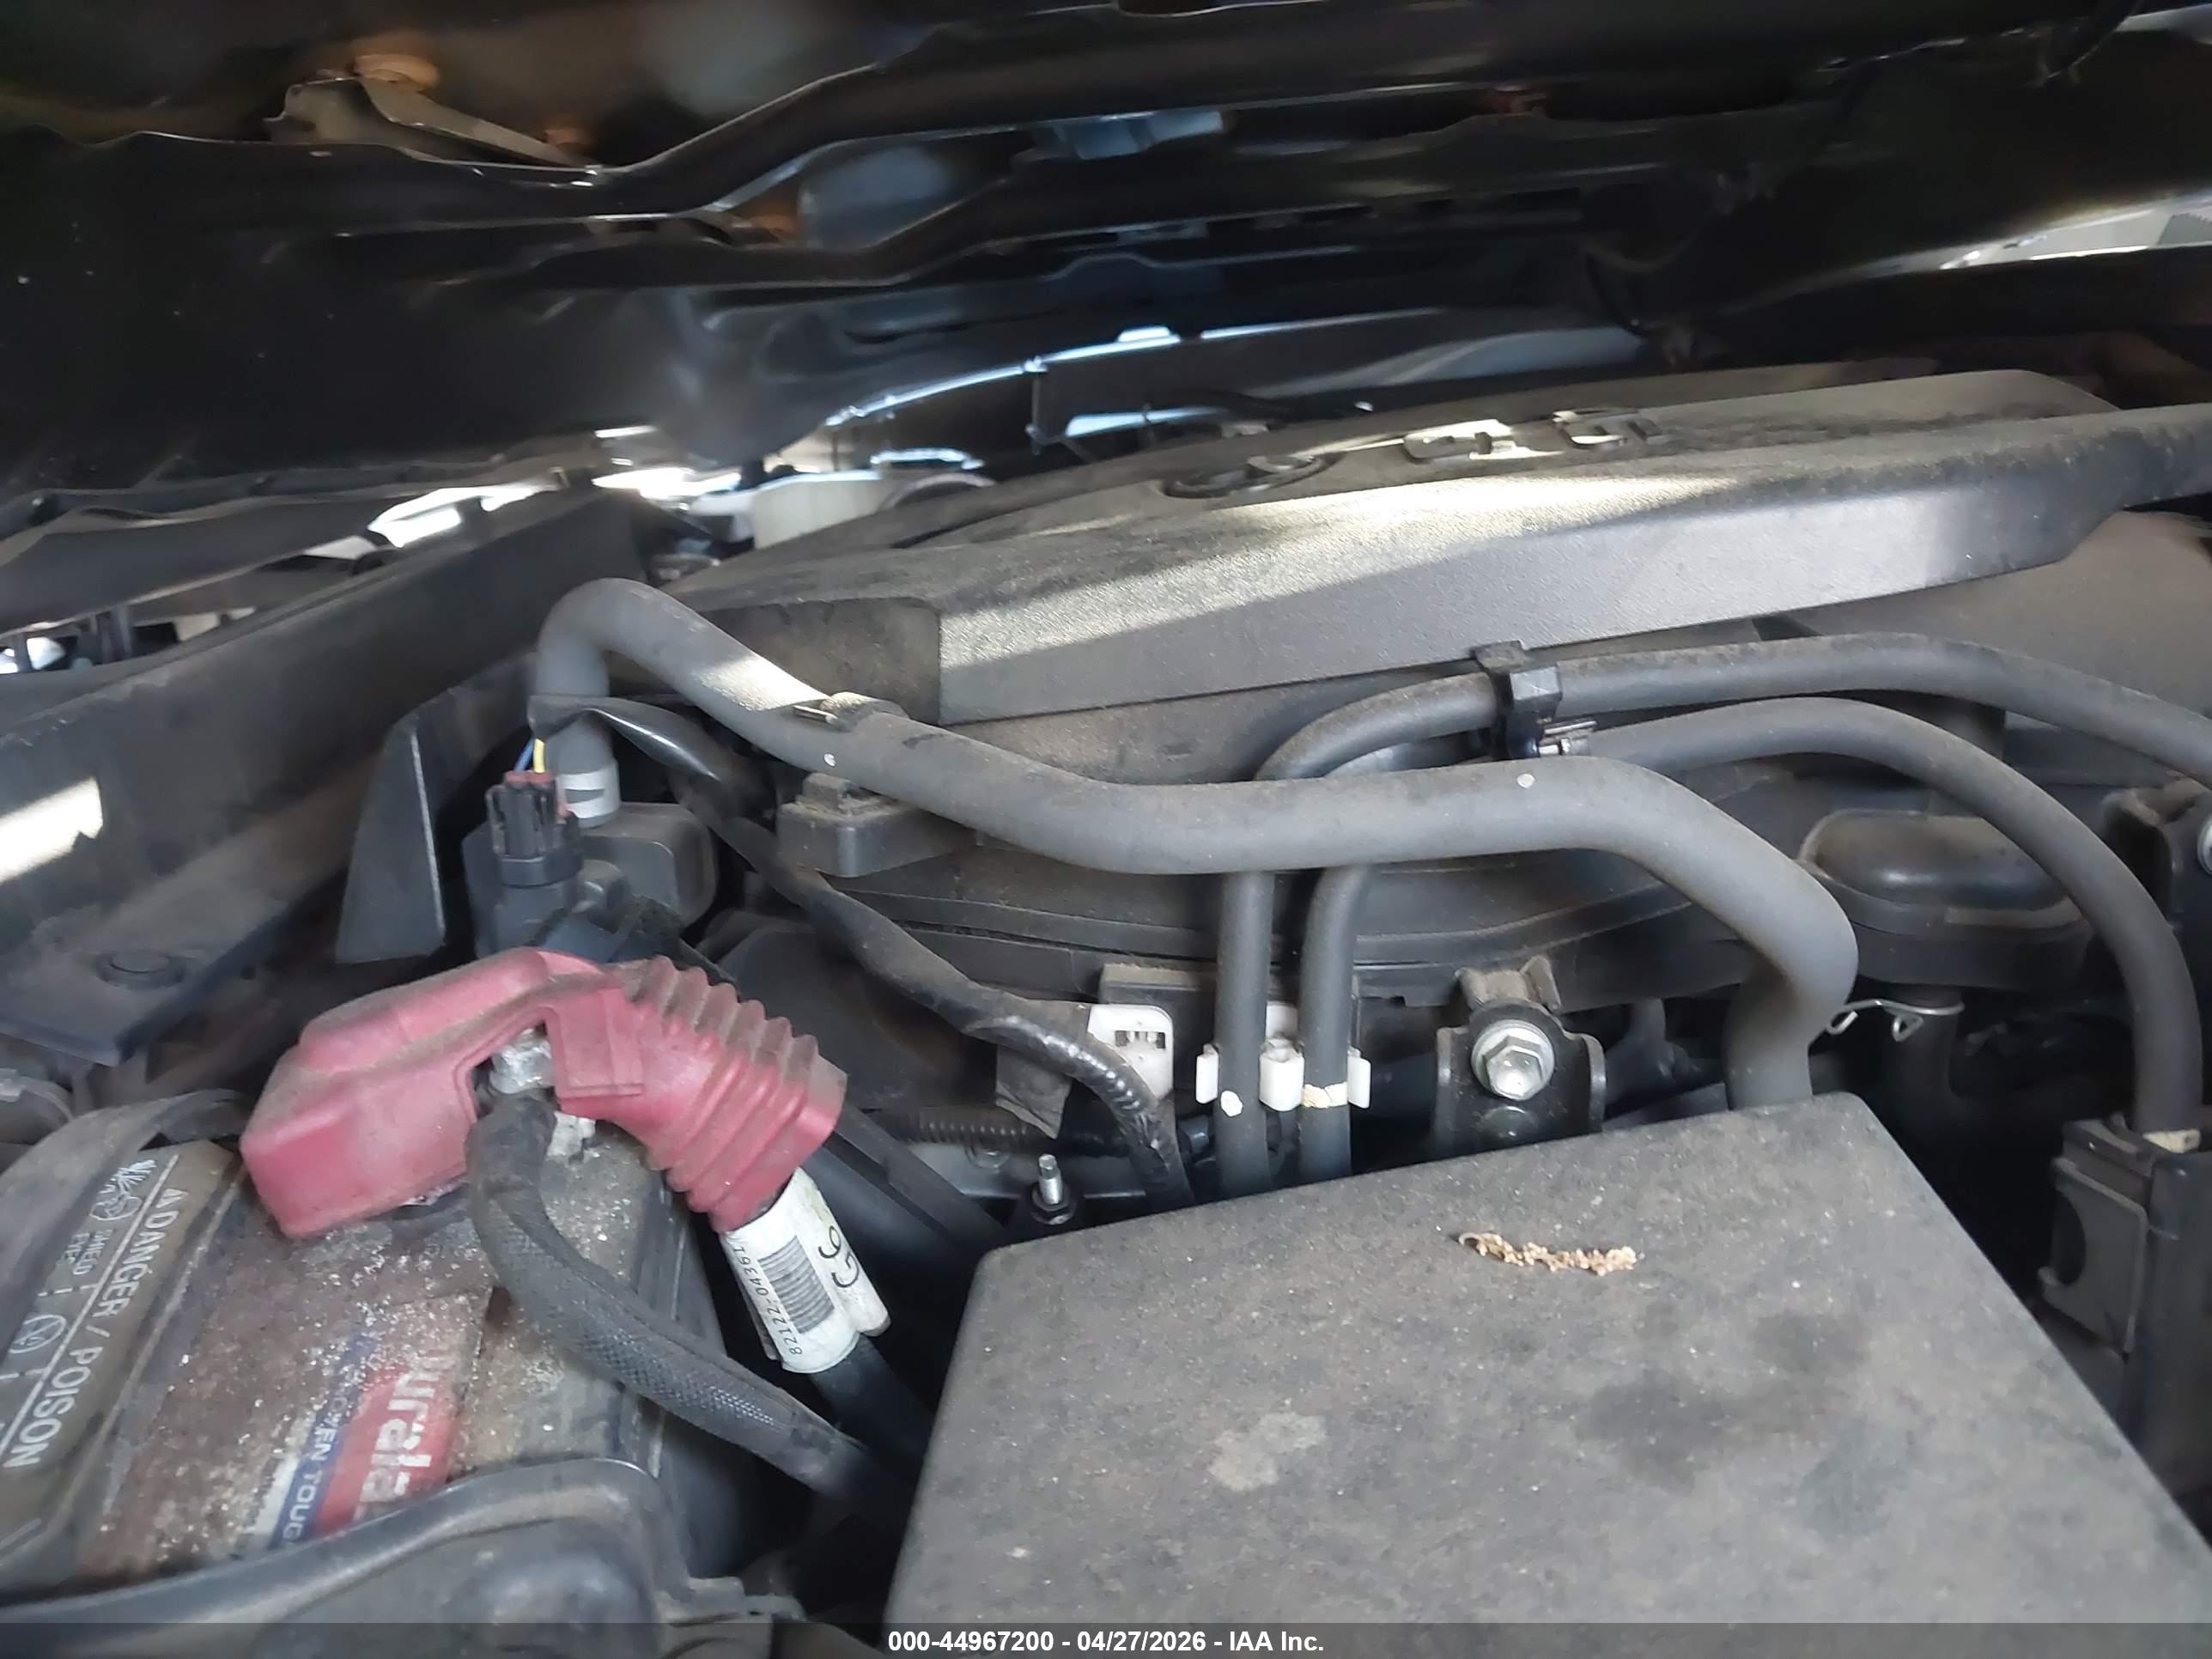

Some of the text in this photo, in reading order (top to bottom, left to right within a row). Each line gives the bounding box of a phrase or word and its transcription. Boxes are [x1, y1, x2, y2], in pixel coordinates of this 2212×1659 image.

[91, 1211, 179, 1317] DANGER
[732, 1245, 803, 1356] 82122-04361
[2, 1346, 104, 1468] POISON
[283, 1468, 324, 1541] TOUG
